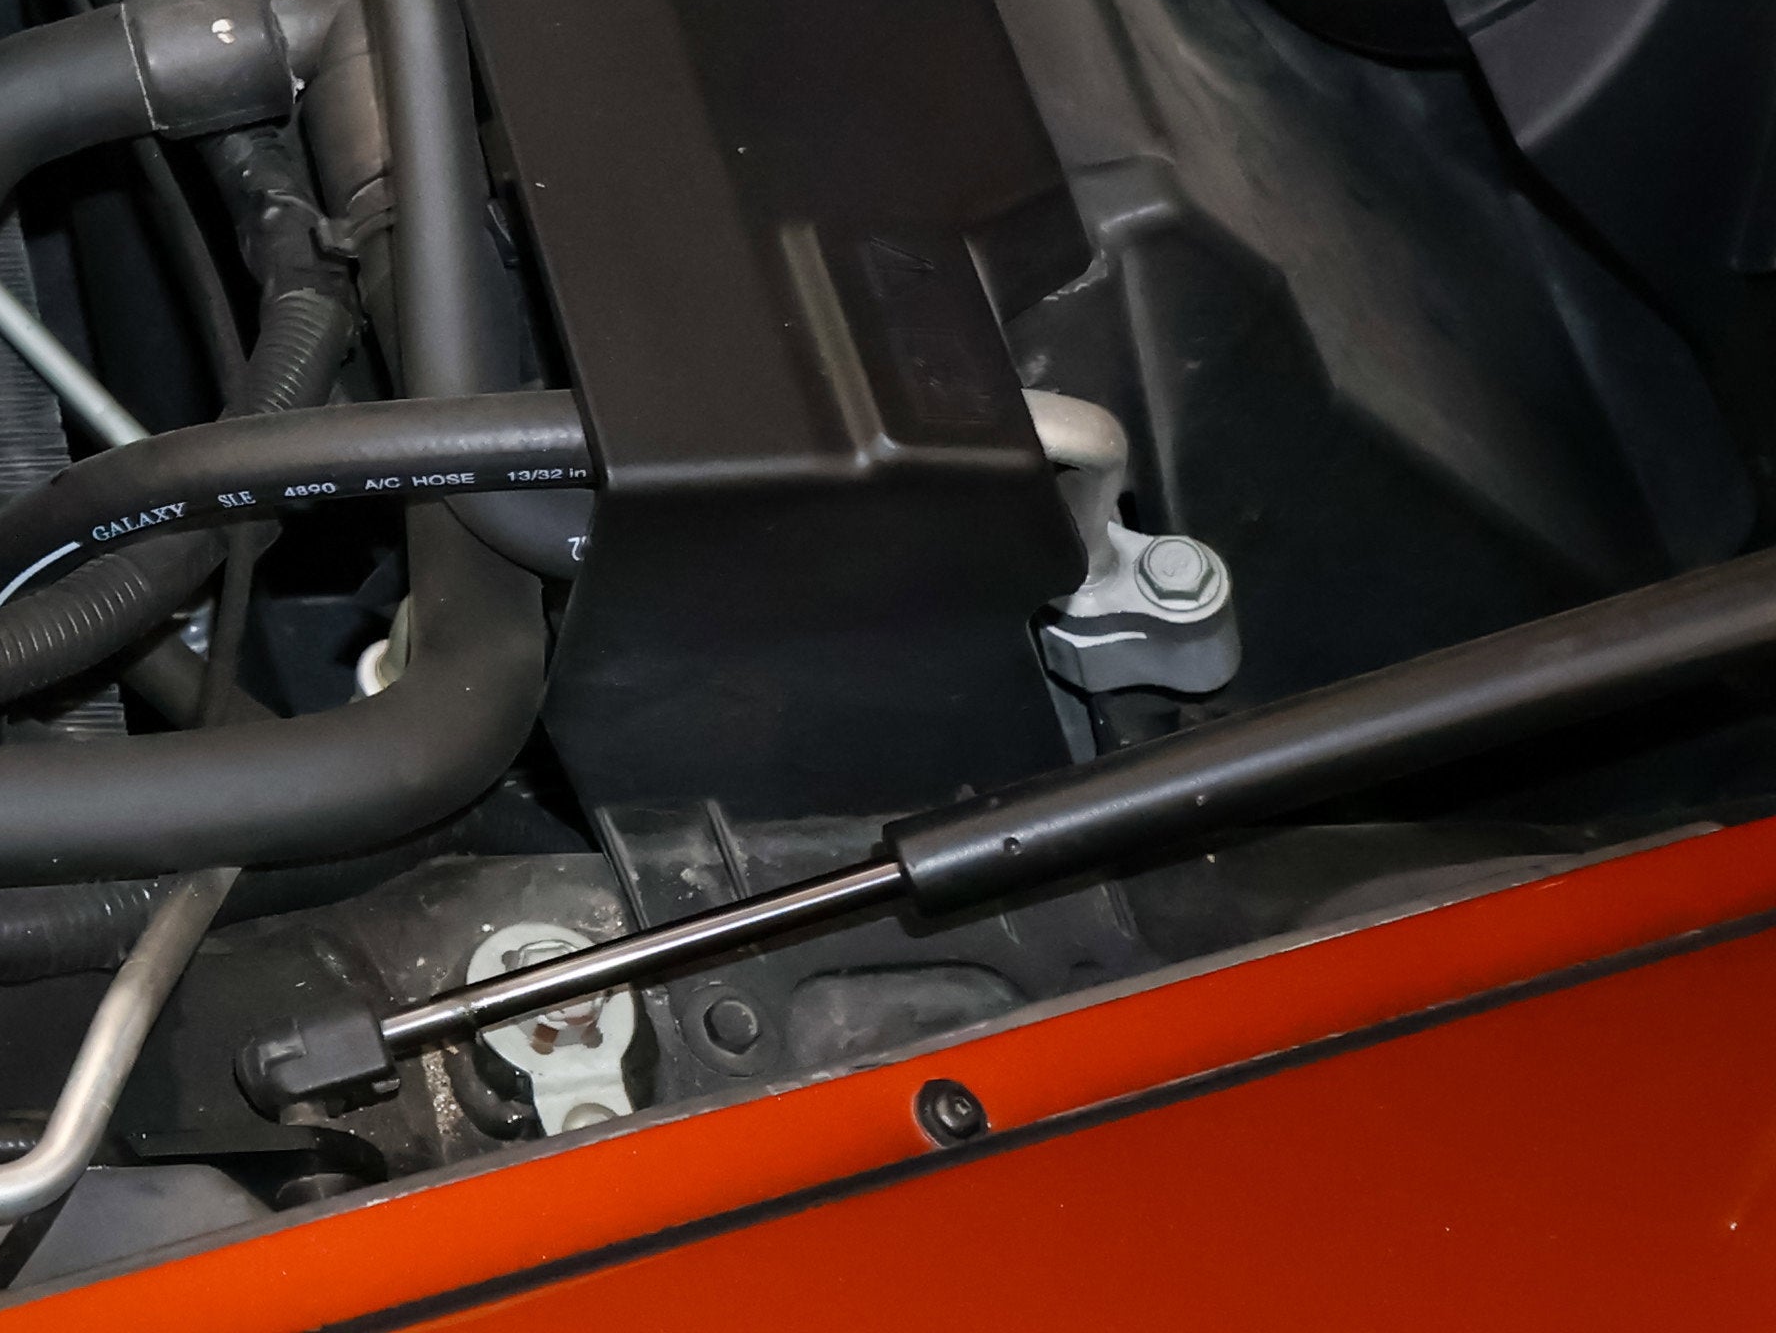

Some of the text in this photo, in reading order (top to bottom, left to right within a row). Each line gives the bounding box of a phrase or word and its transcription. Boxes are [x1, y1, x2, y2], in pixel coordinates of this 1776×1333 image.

[91, 467, 587, 541] GALAXY SLE 4890 A/C HOSE 13/32 in
